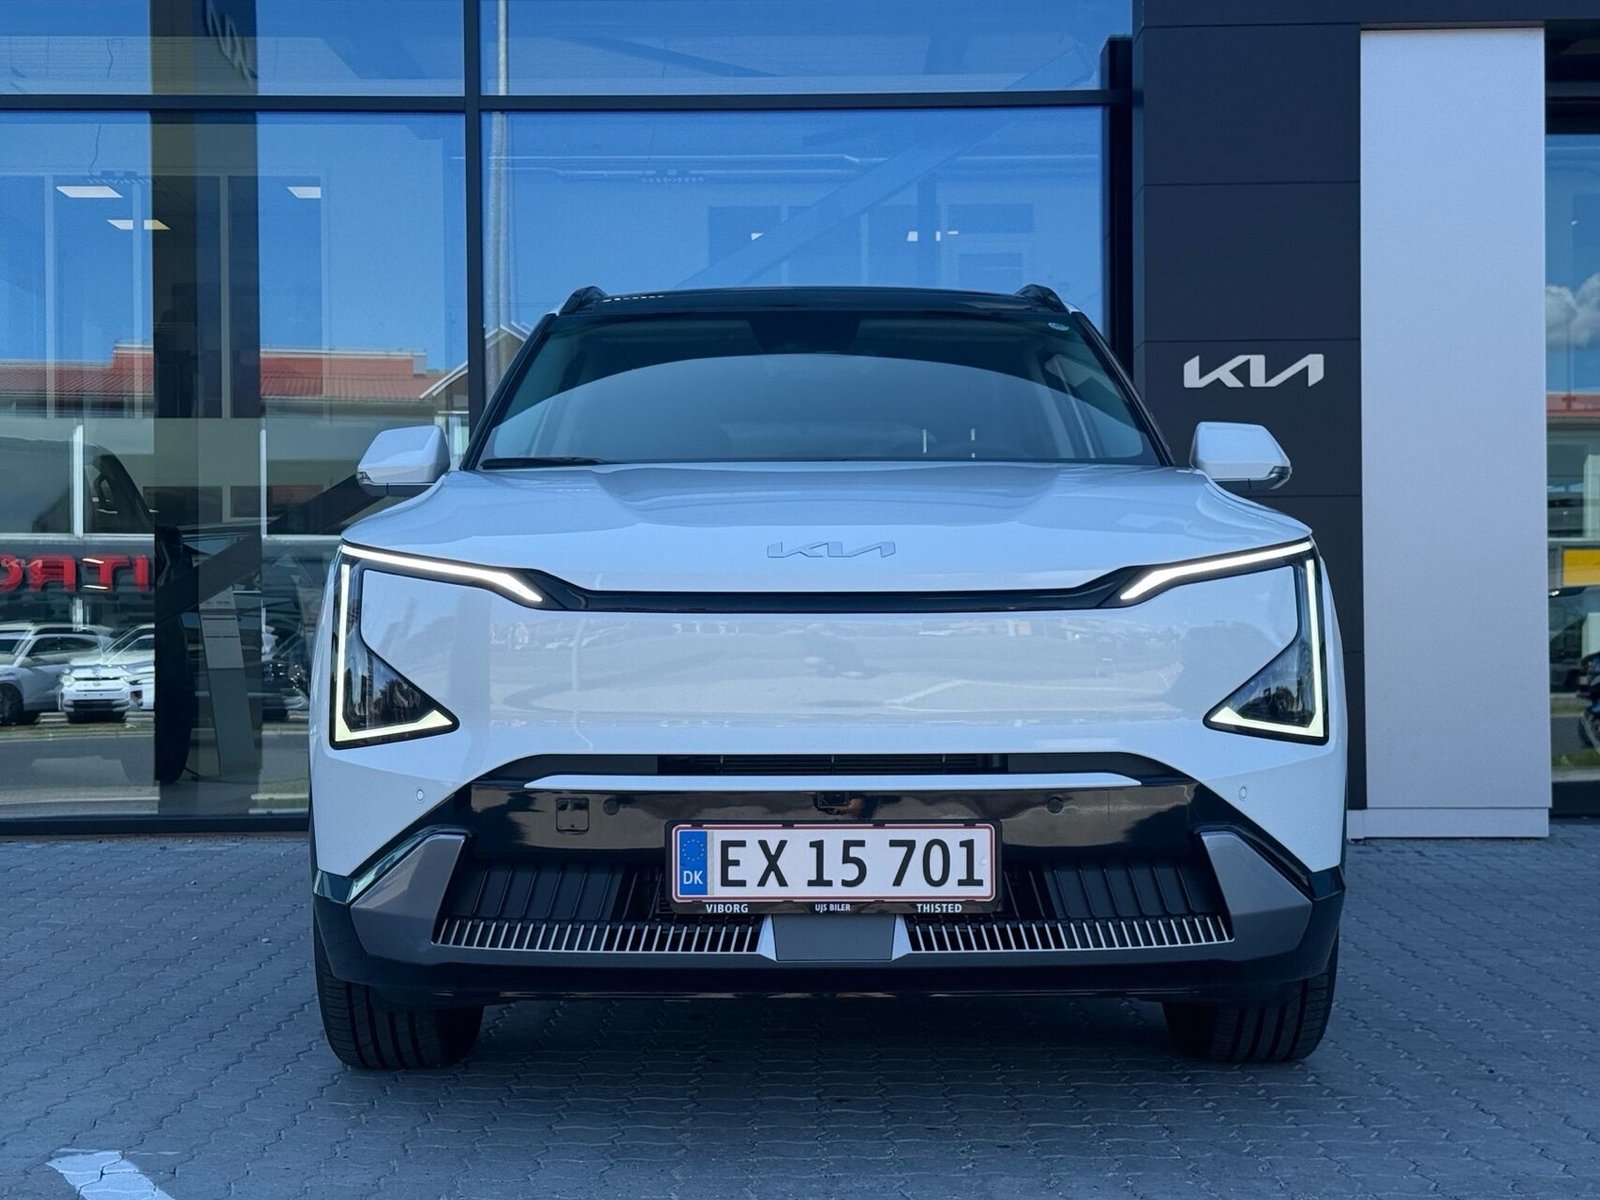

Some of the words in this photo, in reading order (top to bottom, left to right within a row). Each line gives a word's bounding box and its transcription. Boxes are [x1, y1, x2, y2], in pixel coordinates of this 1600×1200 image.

[1184, 354, 1324, 388] KIA
[767, 541, 896, 558] KIA
[720, 839, 789, 887] EX
[807, 839, 867, 887] 15
[889, 838, 984, 887] 701
[683, 870, 703, 885] DK
[705, 903, 749, 913] VIBORG
[829, 903, 851, 911] BILER
[916, 903, 962, 913] THISTED
